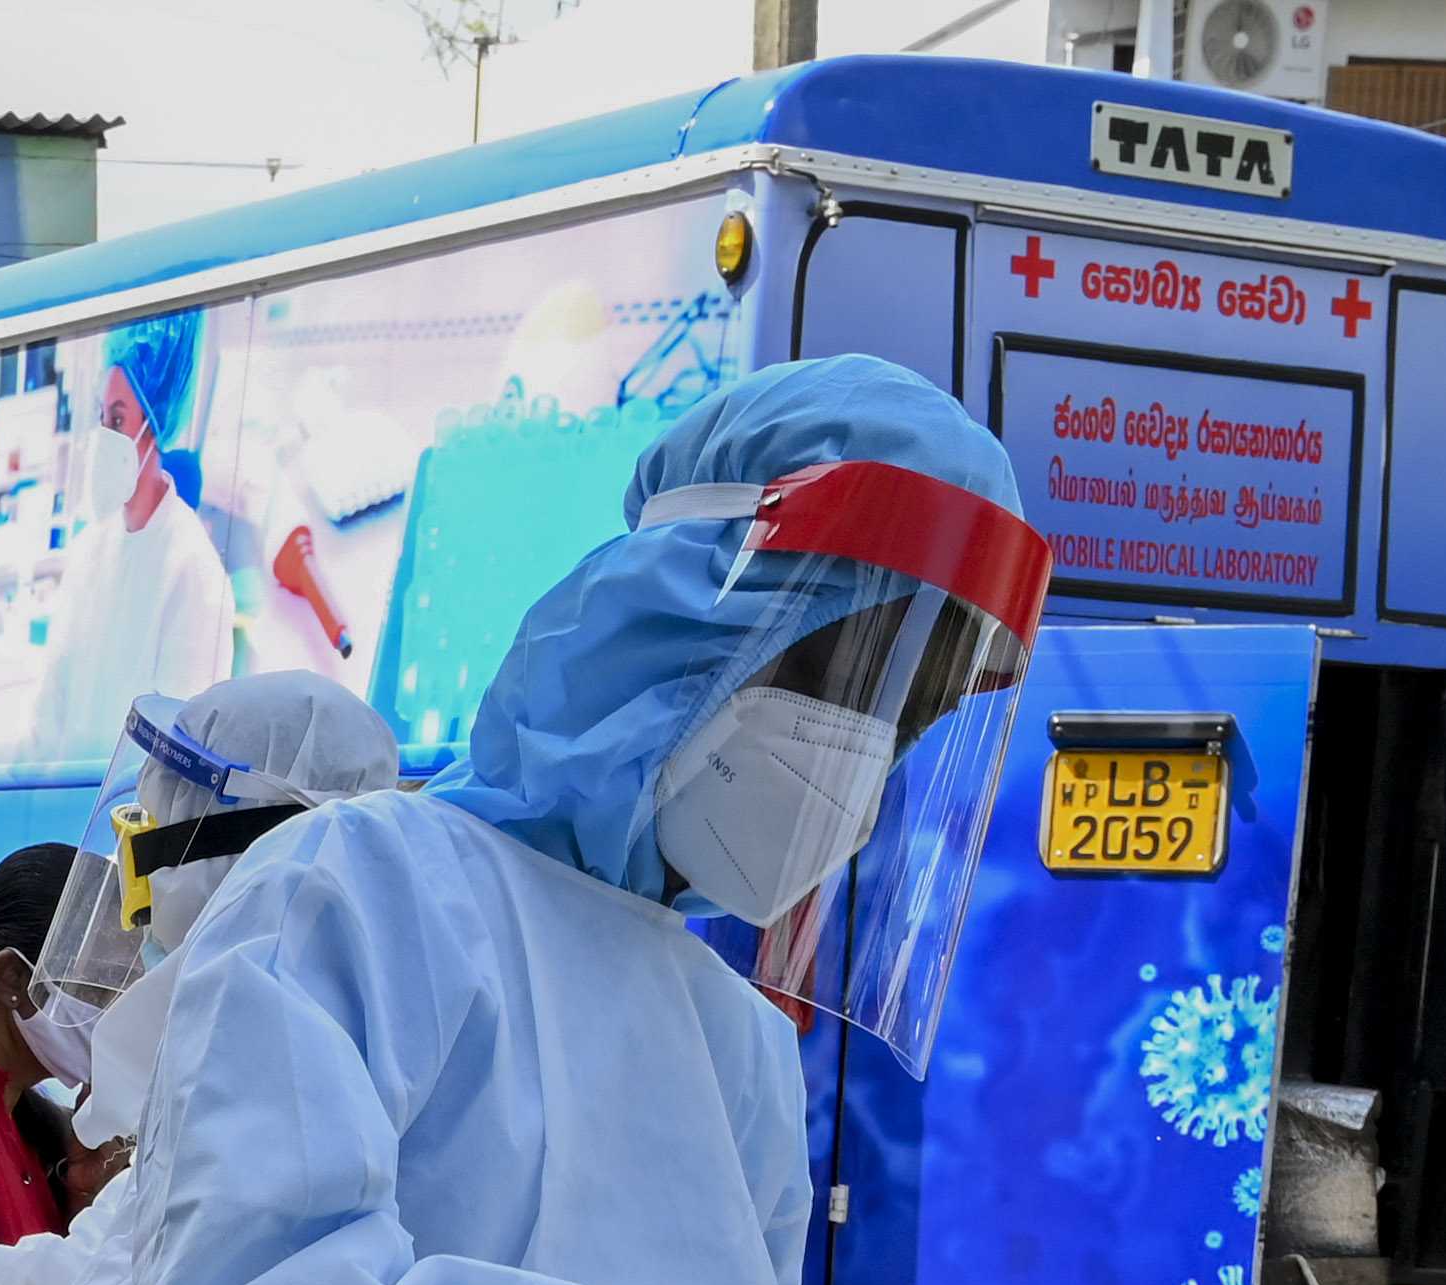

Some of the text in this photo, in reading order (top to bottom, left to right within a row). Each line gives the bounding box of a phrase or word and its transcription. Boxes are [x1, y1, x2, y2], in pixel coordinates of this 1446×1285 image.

[1109, 117, 1275, 186] TATA
[1217, 274, 1306, 325] සේවා
[1054, 394, 1117, 443] ජංගම
[1197, 409, 1323, 463] රසායනාගාරය
[1048, 456, 1322, 528] மொபைல் மருத்துவ ஆய்வகம்
[1047, 533, 1320, 586] MOBILE MEDICAL LABORATORY
[706, 751, 737, 784] KN95
[1069, 815, 1193, 861] 2059
